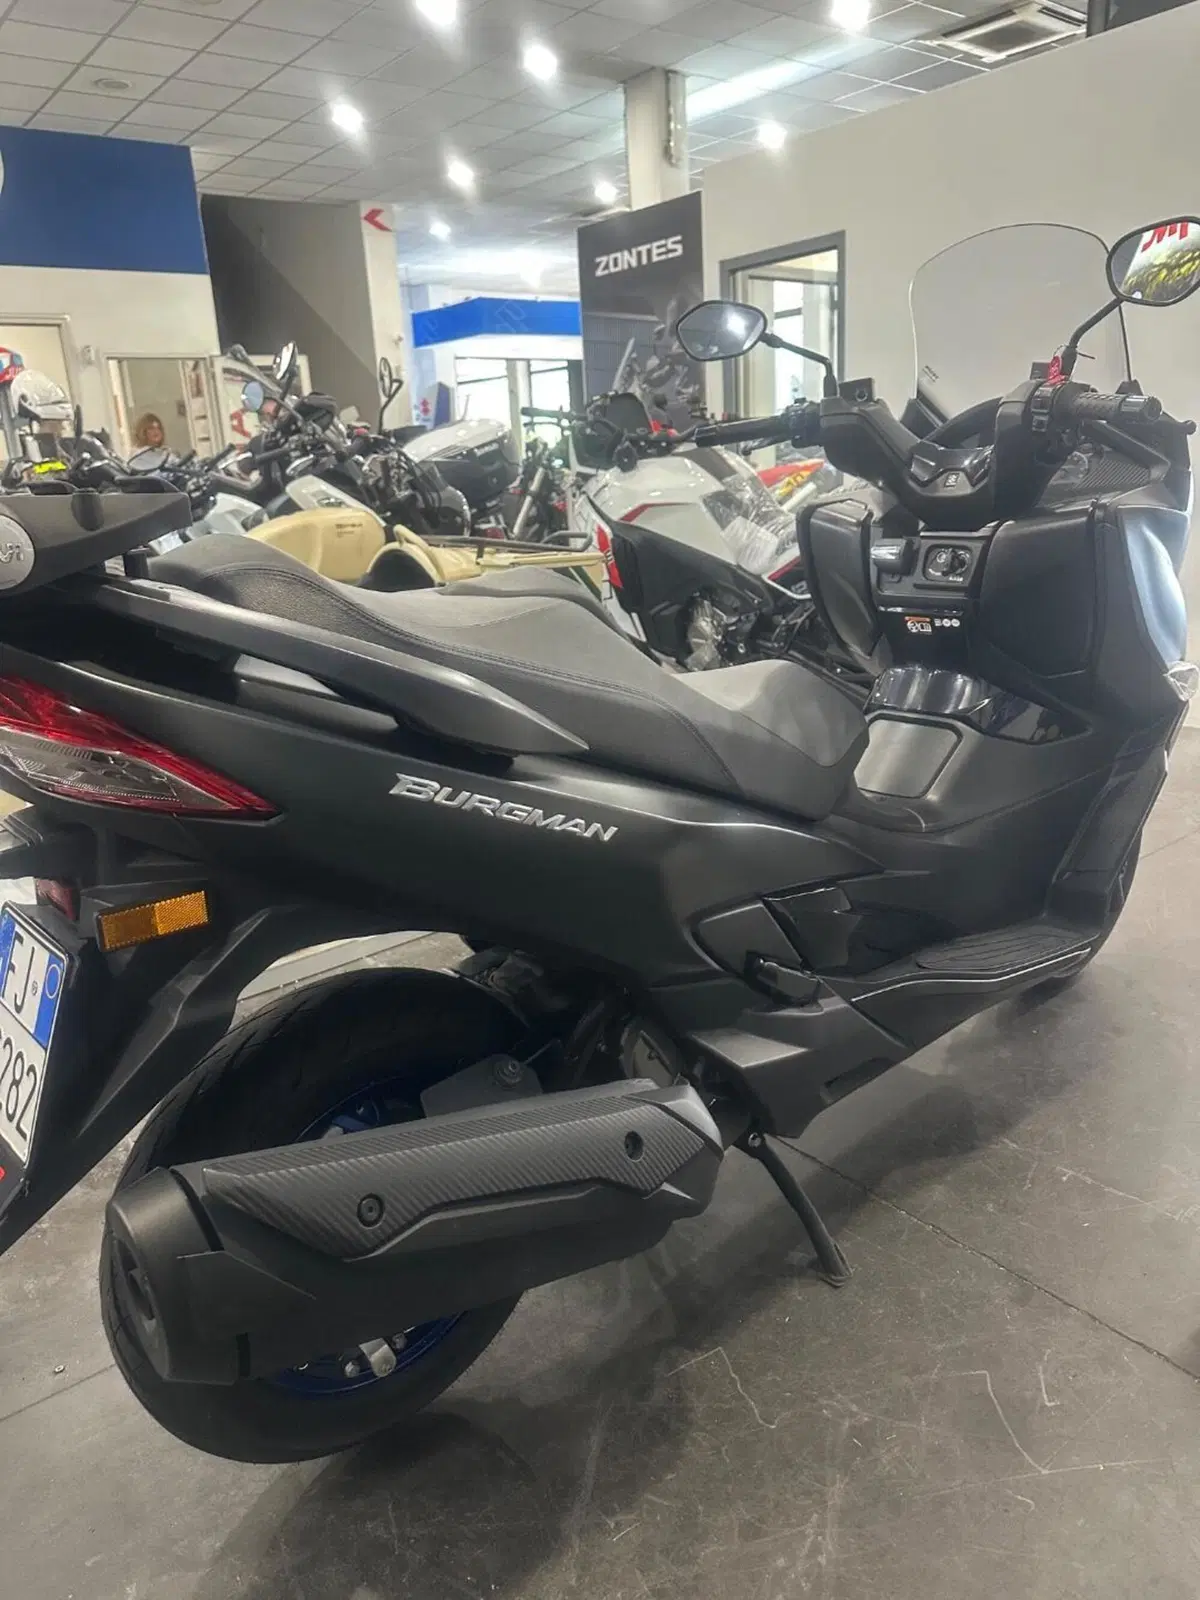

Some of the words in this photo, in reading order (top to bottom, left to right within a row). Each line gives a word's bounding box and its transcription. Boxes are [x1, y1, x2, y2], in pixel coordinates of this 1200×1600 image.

[594, 234, 684, 277] ZONTES
[388, 772, 619, 842] BURGMAN
[1, 930, 36, 1014] FJ
